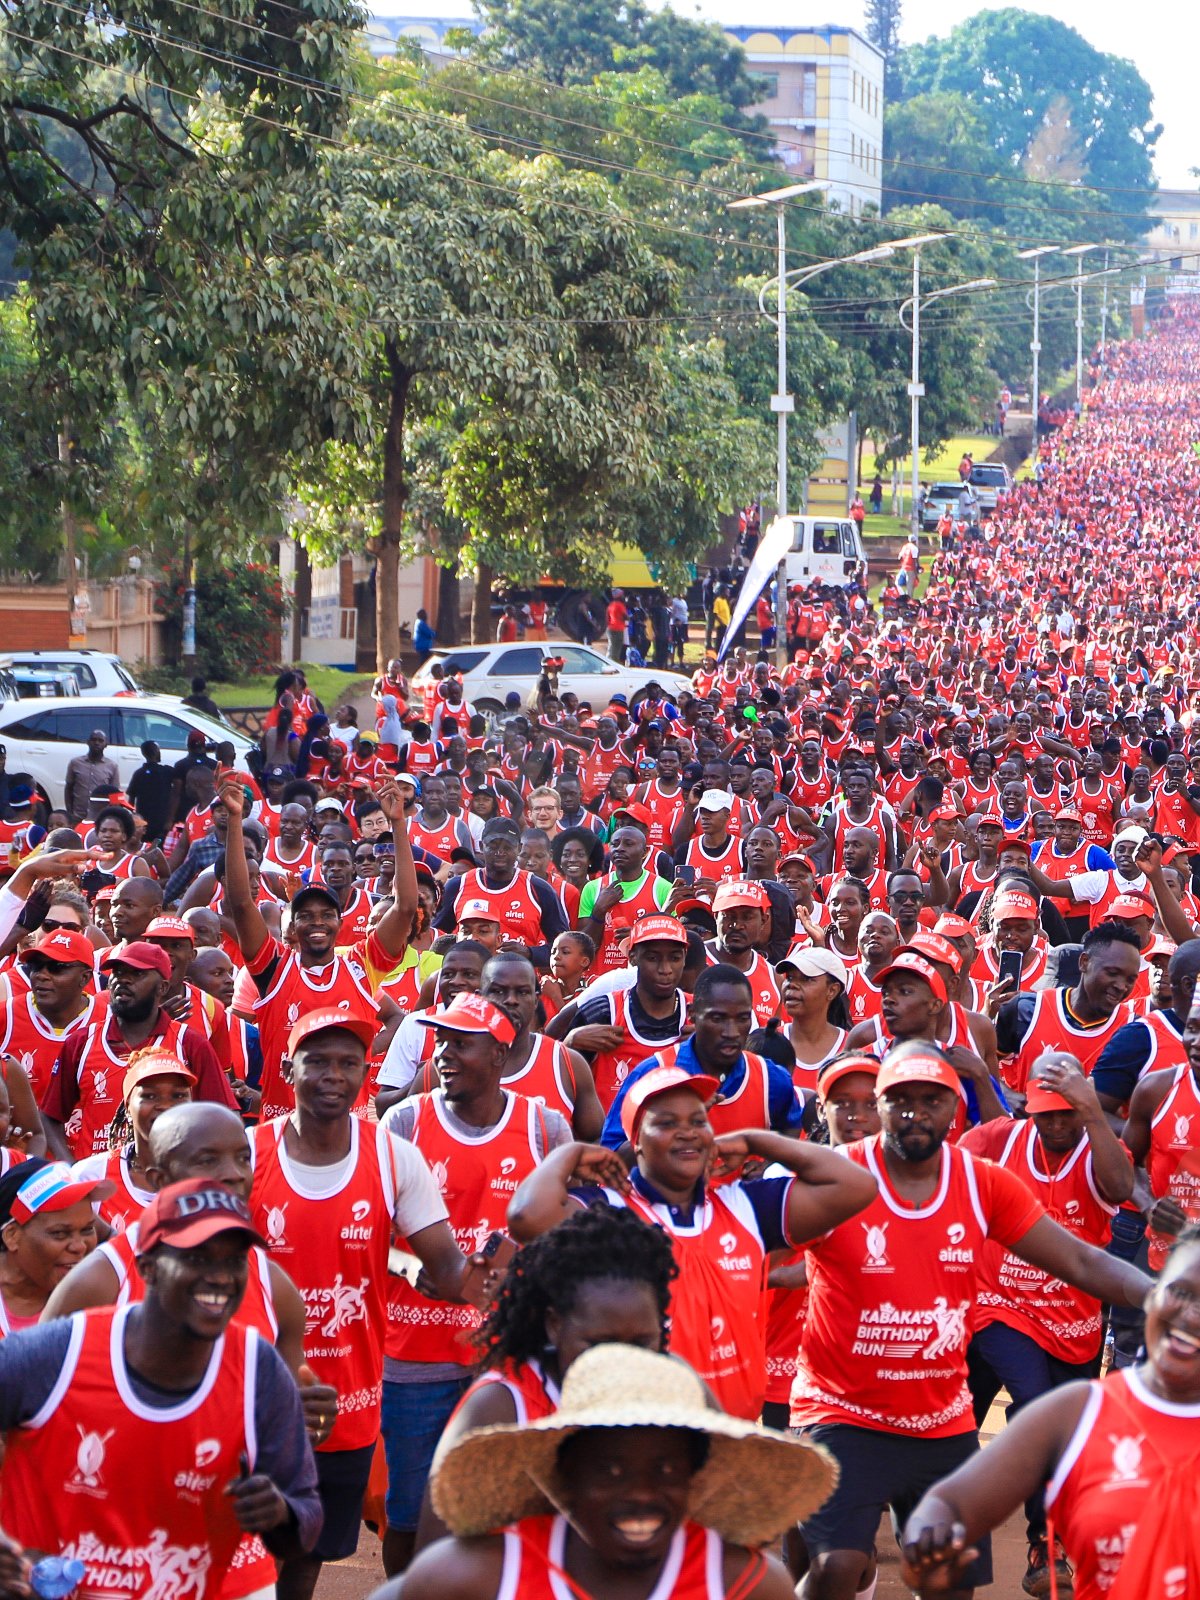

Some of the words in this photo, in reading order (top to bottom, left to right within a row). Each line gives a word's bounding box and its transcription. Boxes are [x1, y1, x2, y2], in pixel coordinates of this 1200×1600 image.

[505, 911, 524, 920] airtel
[756, 1004, 773, 1014] airtel
[340, 1224, 373, 1240] airtel
[938, 1249, 974, 1263] airtel
[718, 1256, 752, 1271] airtel
[999, 1276, 1017, 1288] RUN
[860, 1310, 934, 1324] KABAKA'S
[856, 1327, 933, 1342] BIRTHDAY
[852, 1342, 886, 1356] RUN
[79, 1566, 146, 1590] THDAY
